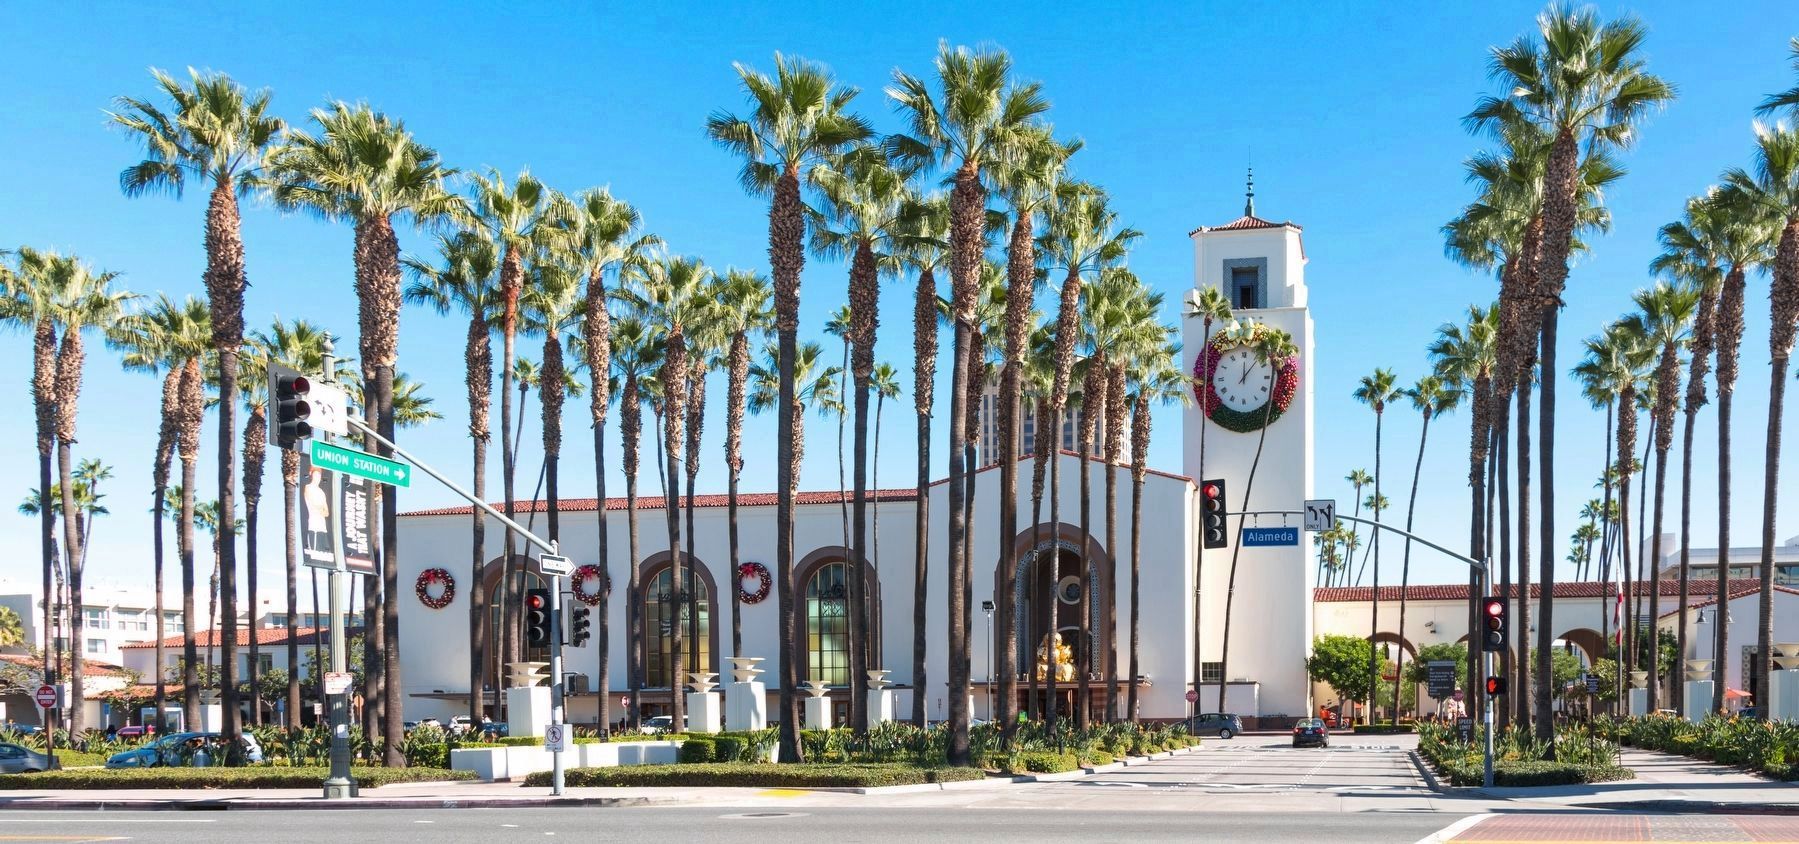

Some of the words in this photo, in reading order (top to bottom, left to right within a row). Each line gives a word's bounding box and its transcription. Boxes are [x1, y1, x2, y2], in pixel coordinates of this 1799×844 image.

[317, 448, 349, 466] UNION
[353, 458, 390, 477] STATION
[345, 490, 357, 542] JOURNEY
[357, 531, 369, 554] THAT
[1247, 532, 1294, 542] Alameda
[1462, 730, 1468, 741] 5
